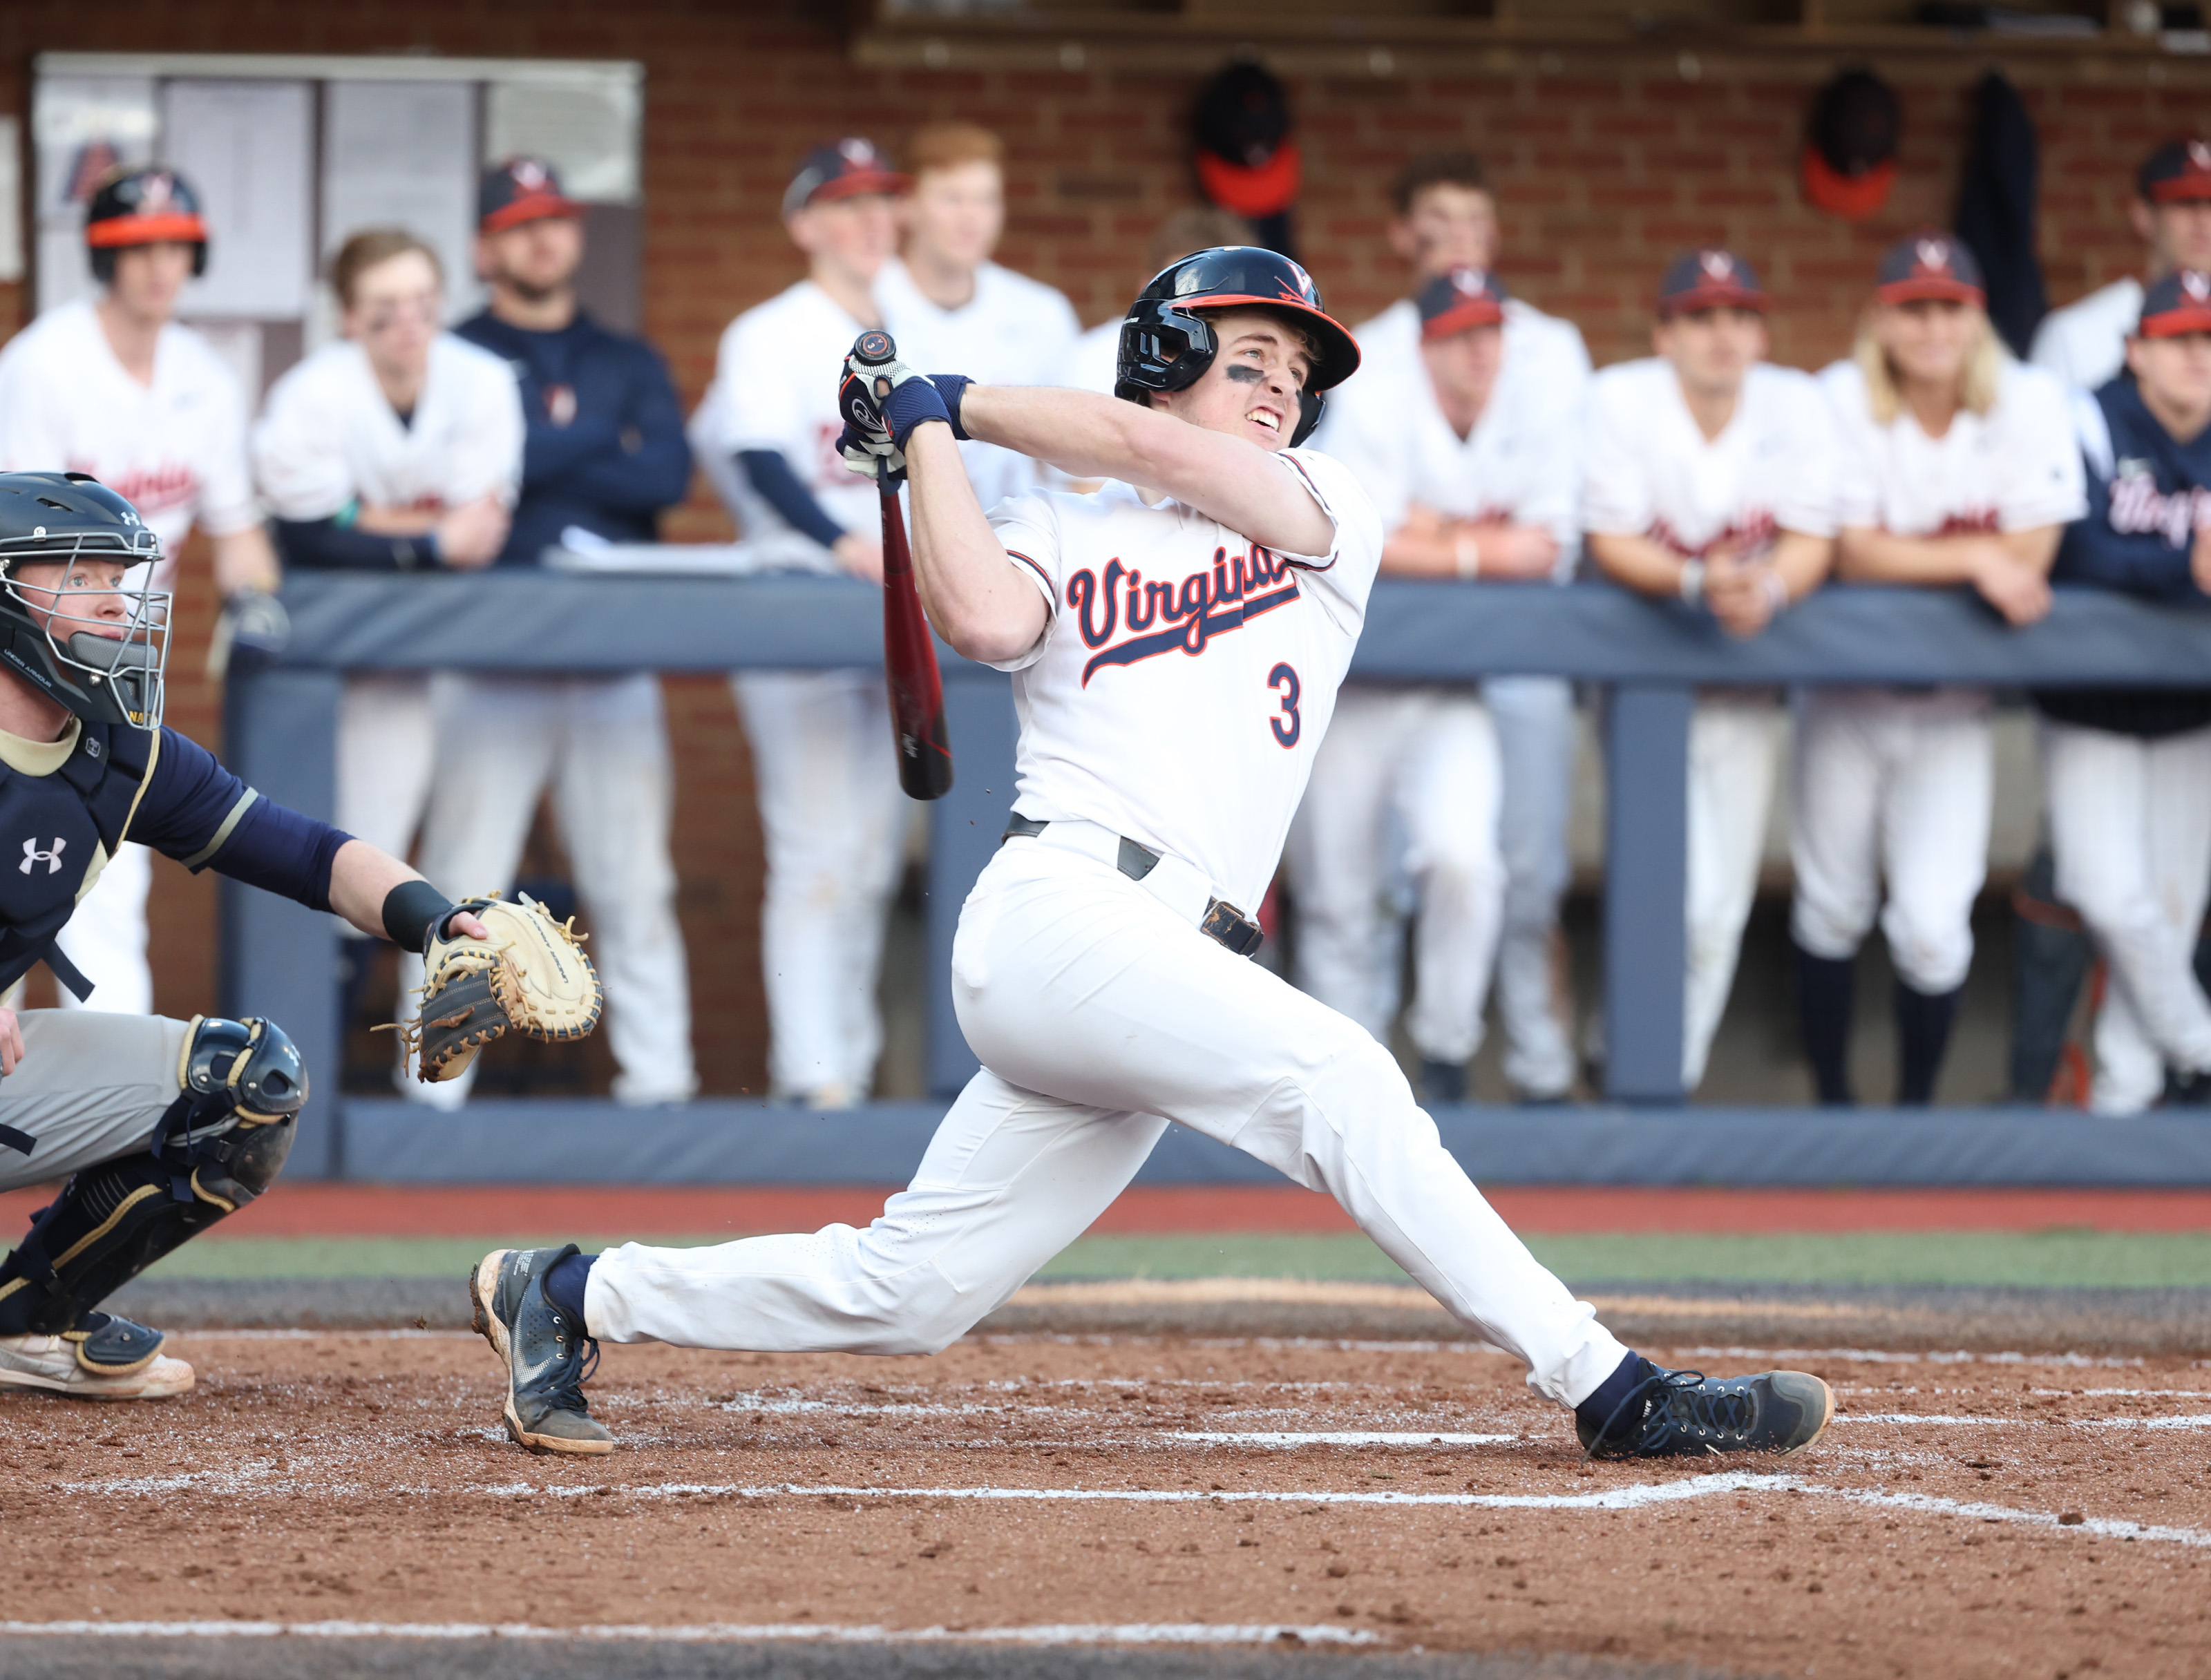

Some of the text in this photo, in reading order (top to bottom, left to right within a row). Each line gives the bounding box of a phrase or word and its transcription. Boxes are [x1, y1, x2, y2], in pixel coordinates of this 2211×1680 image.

[1066, 544, 1293, 658] Virgina
[4, 649, 53, 688] UNDER ARMOUR
[1267, 661, 1300, 750] 3
[550, 951, 569, 984] UNDER
